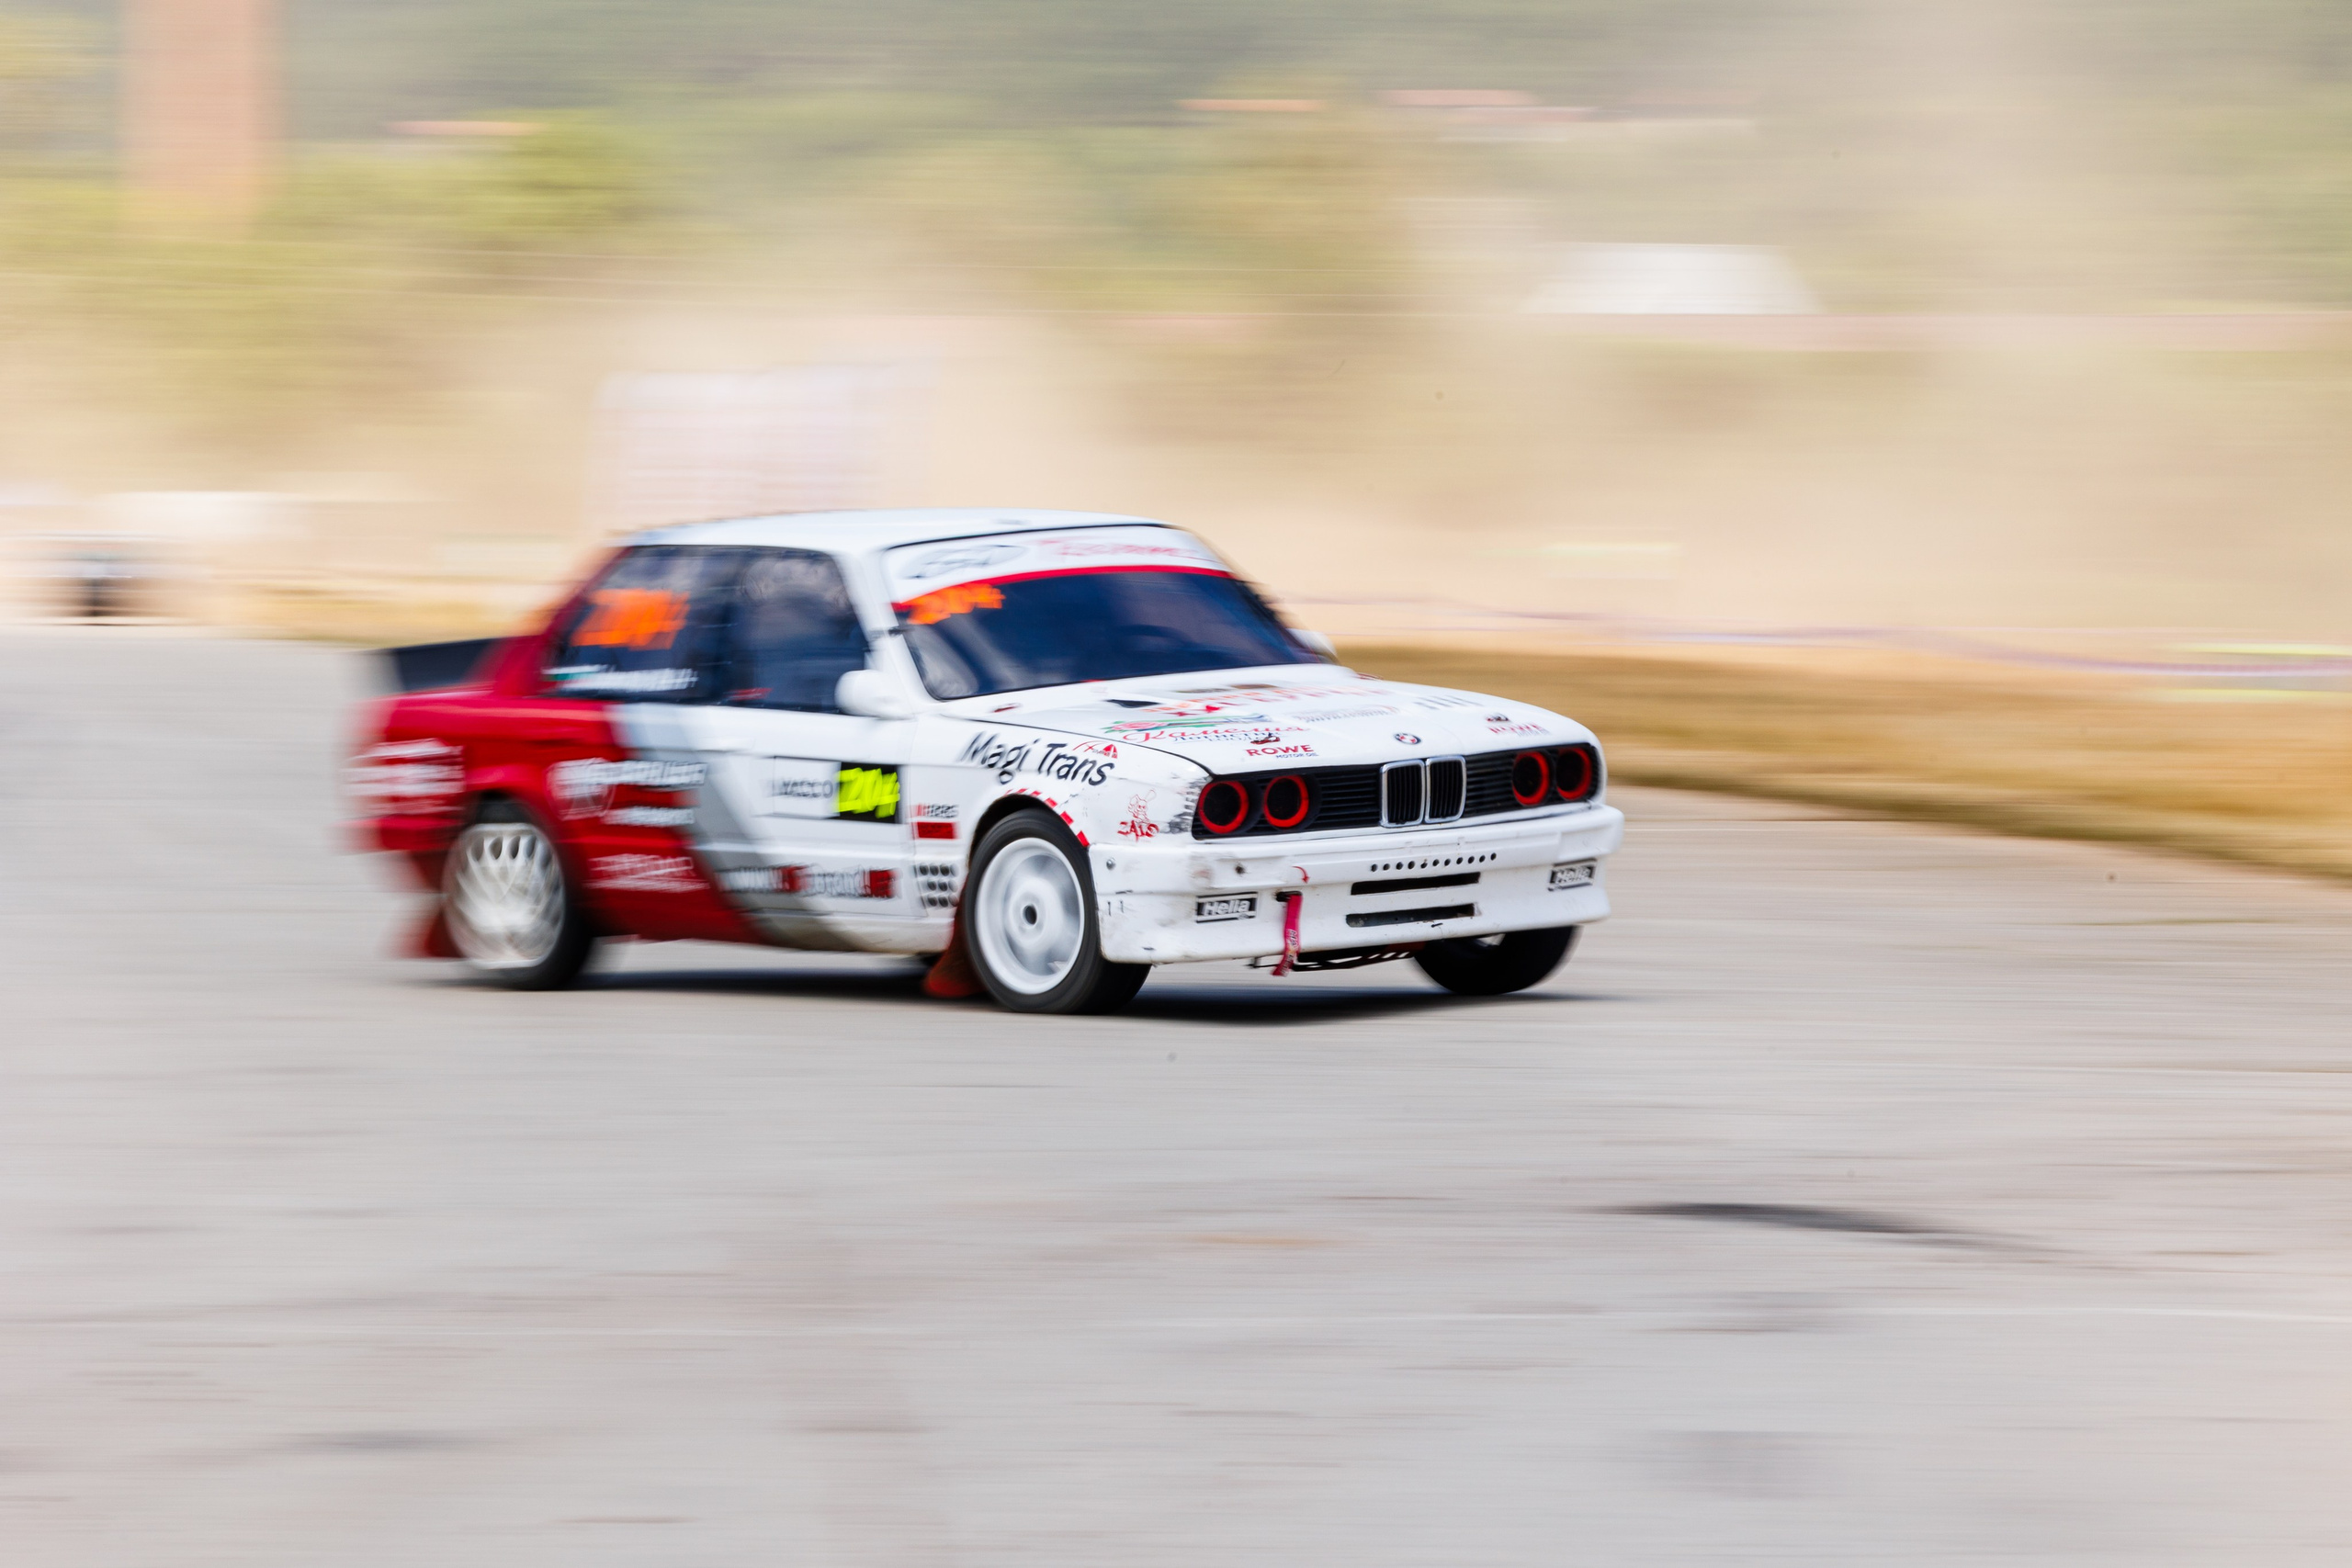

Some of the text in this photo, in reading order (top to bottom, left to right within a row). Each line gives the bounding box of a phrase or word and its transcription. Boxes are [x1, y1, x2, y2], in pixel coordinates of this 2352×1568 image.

[960, 730, 1115, 786] Magi Trans
[1244, 745, 1315, 757] ROWE
[1203, 899, 1251, 917] Hella
